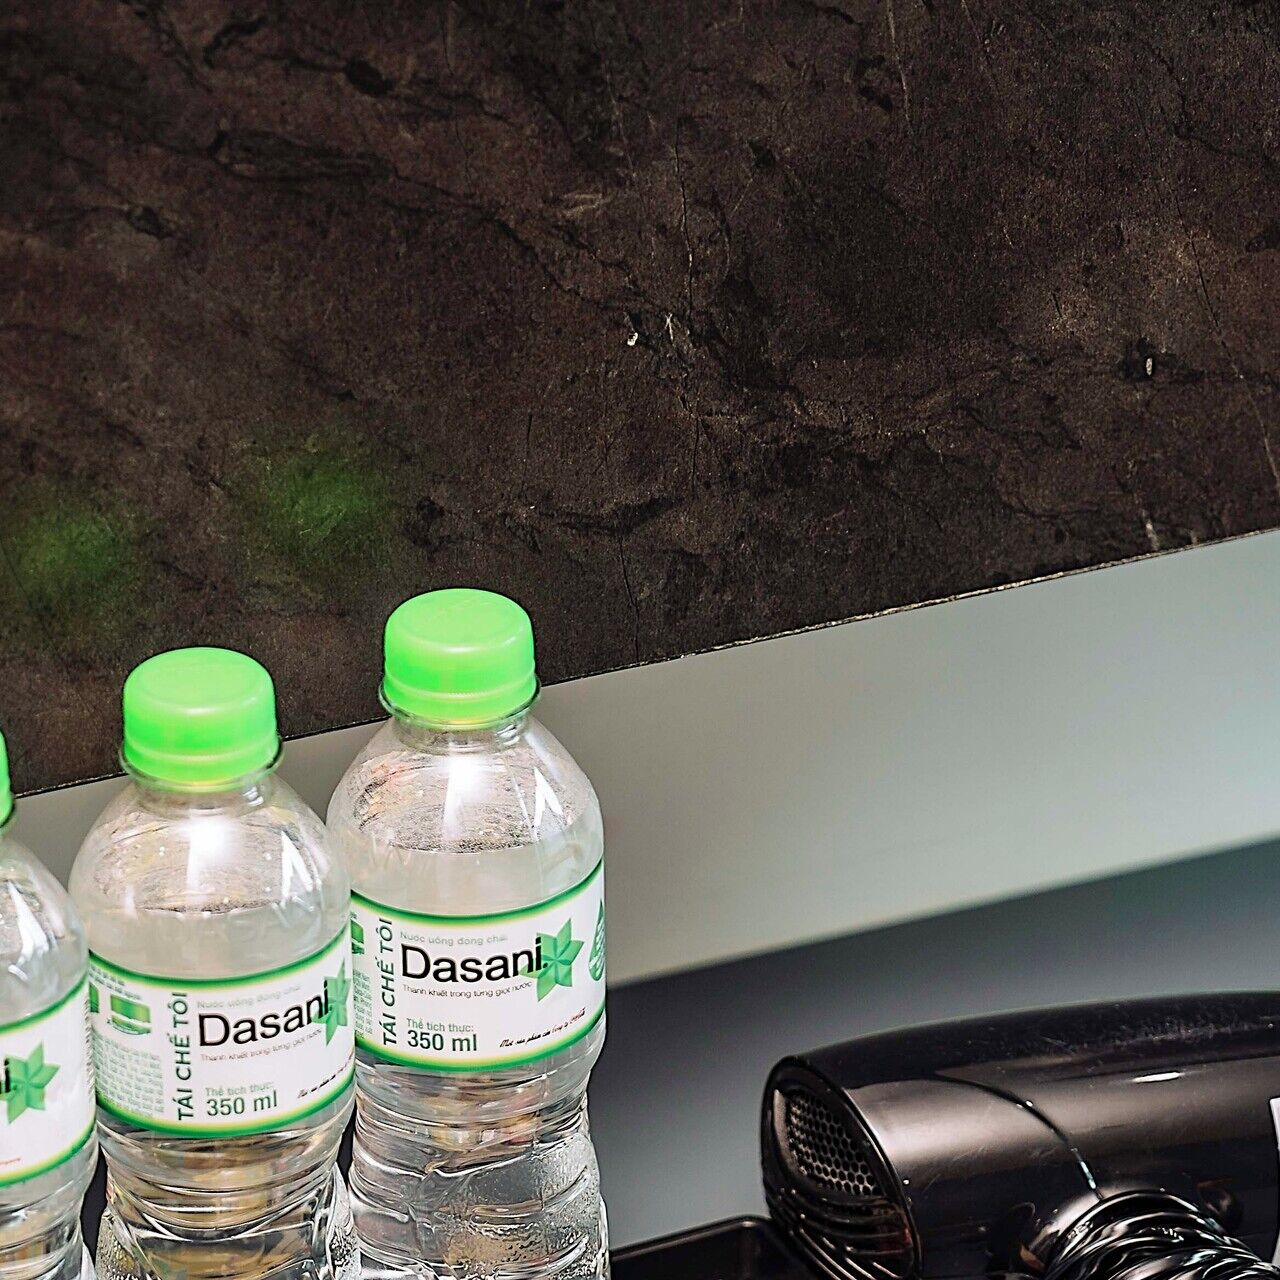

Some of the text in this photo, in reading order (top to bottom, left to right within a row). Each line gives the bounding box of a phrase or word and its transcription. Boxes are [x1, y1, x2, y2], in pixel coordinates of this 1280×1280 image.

[375, 917, 397, 1045] TÁI CHẾ TÔI
[401, 936, 542, 983] Dasani
[199, 980, 328, 1046] Dasani
[407, 1029, 477, 1051] 350 ml
[167, 992, 194, 1121] TÁI CHẾ TÔI
[207, 1089, 277, 1117] 350 ml
